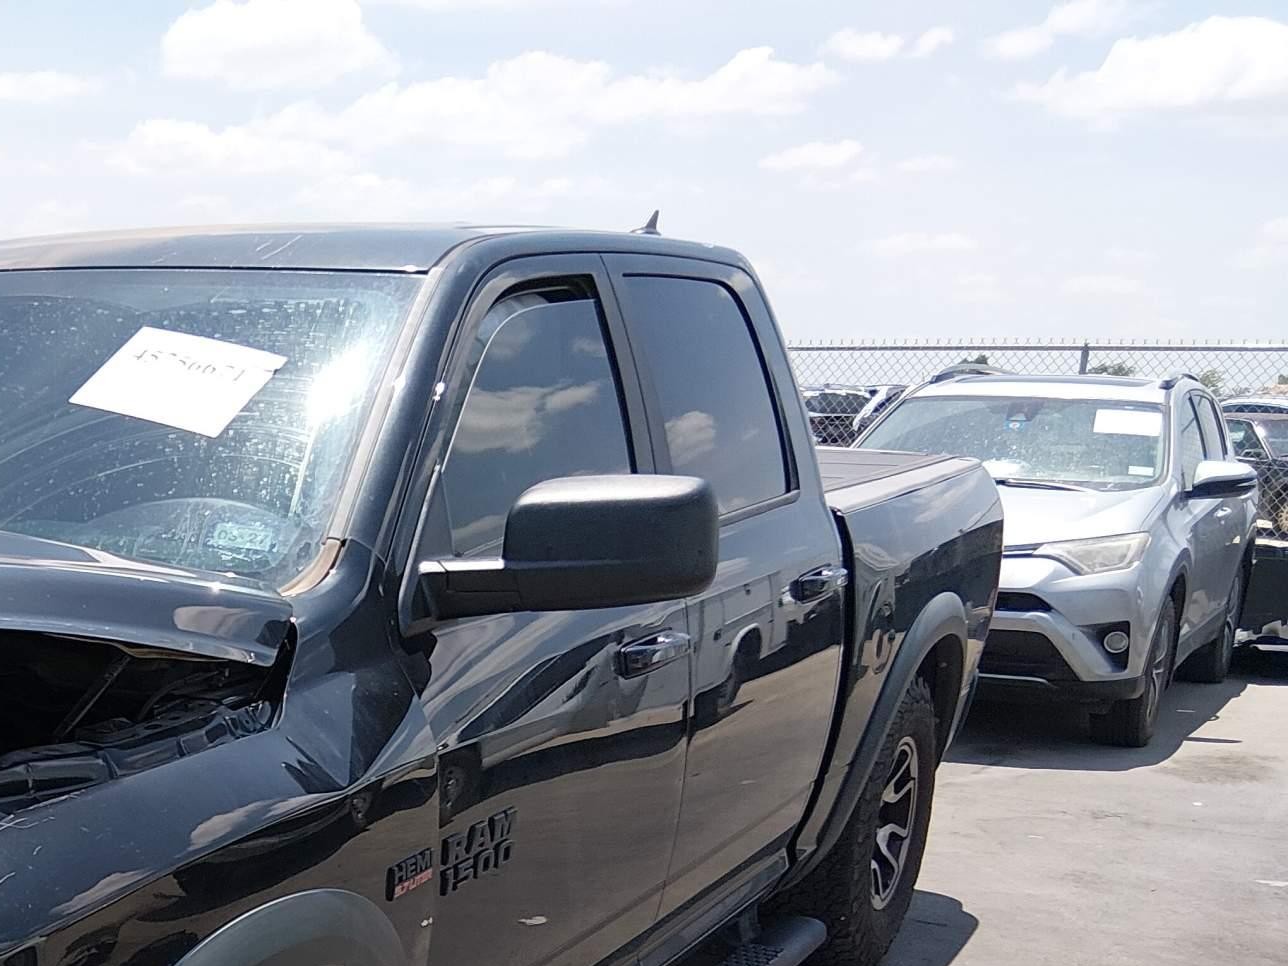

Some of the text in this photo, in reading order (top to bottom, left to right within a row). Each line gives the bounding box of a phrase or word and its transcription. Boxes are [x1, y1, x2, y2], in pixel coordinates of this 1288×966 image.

[133, 349, 246, 383] 455661
[441, 806, 518, 866] RAM
[440, 838, 516, 896] 1500
